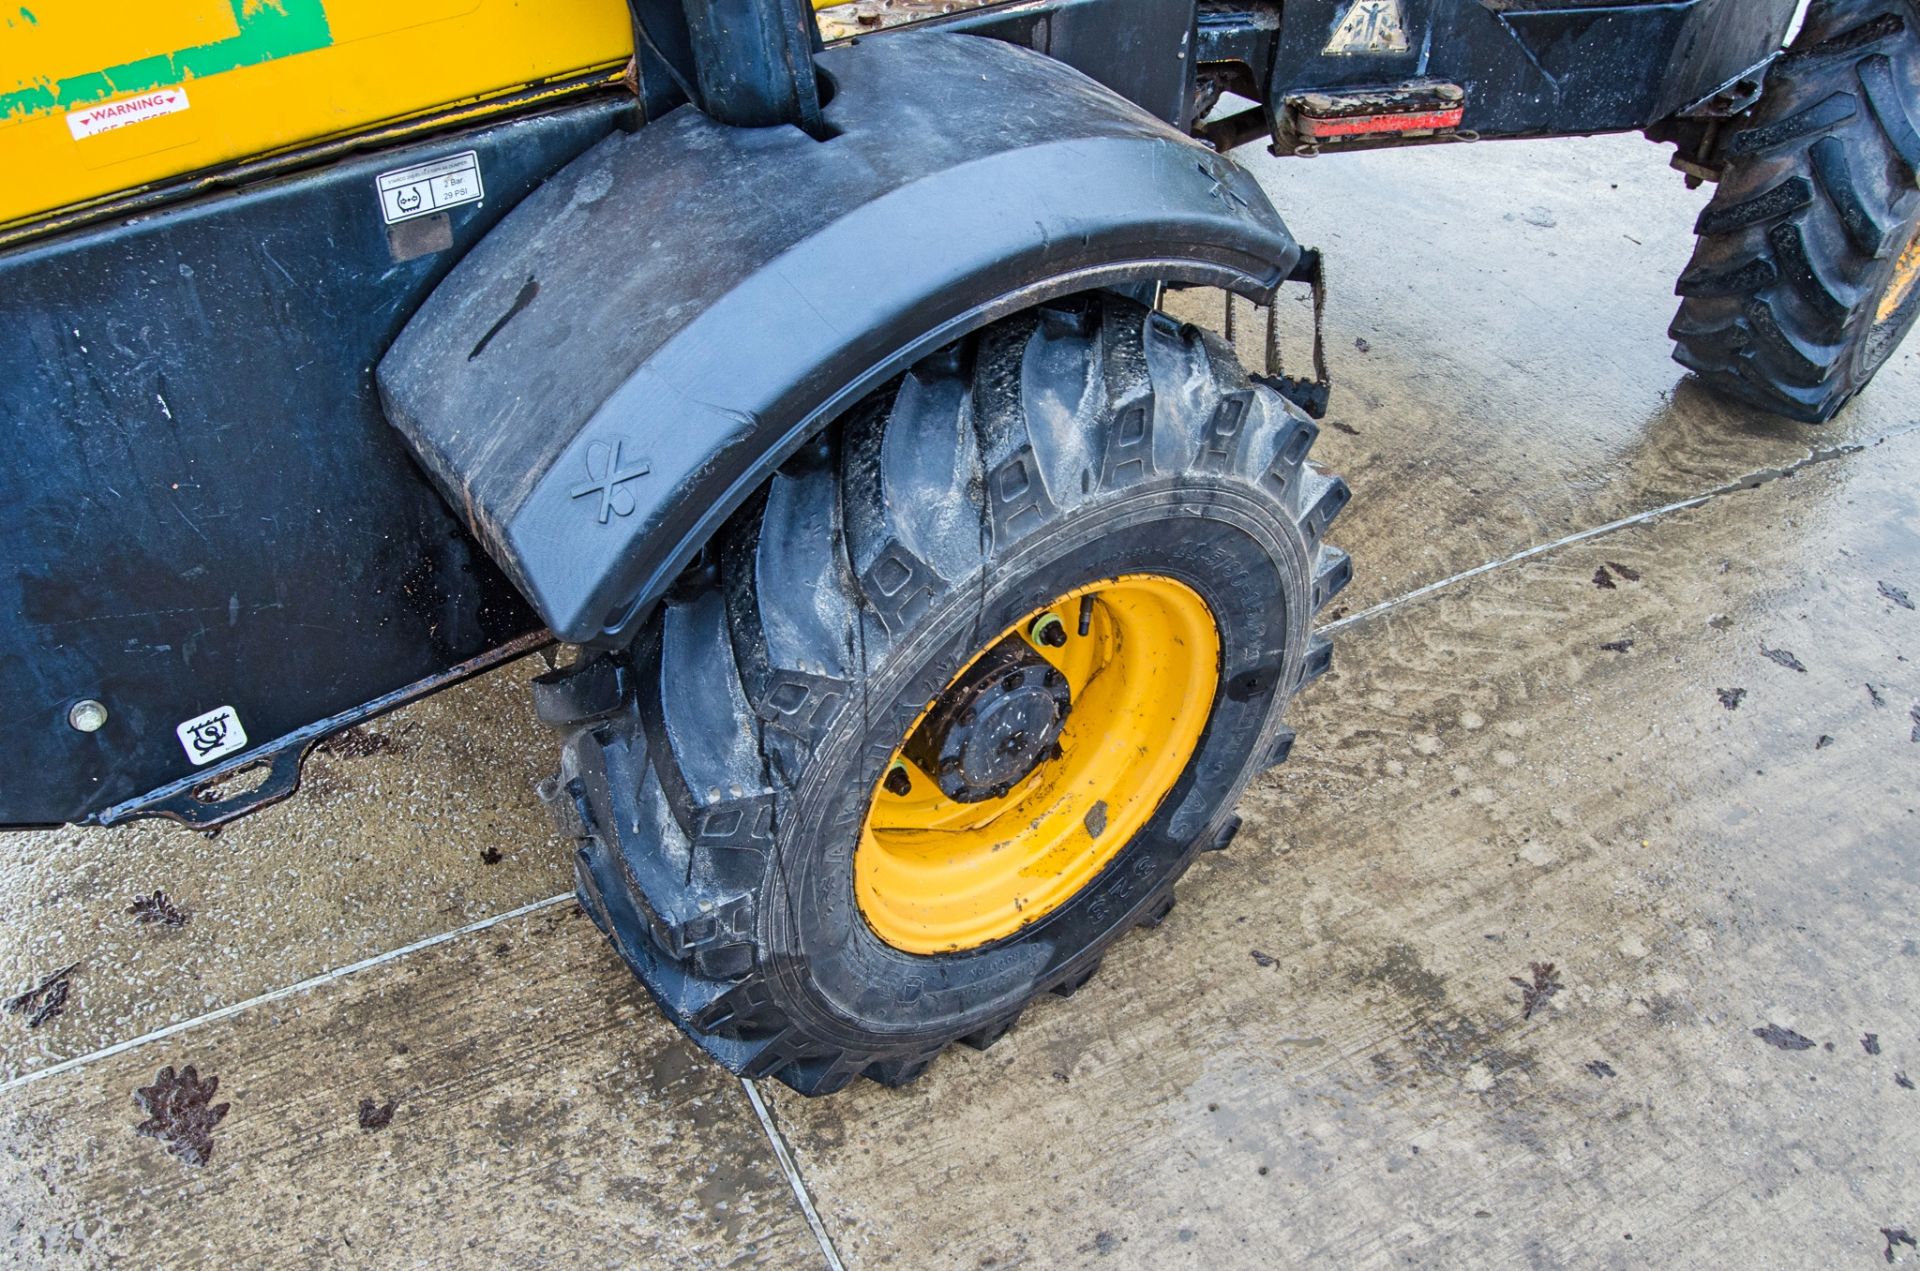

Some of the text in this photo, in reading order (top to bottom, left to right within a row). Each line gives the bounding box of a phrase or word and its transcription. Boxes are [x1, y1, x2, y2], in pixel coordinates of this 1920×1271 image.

[90, 95, 164, 121] WARNING
[450, 177, 463, 185] Bar
[443, 191, 453, 200] 29
[454, 187, 468, 196] PSI
[1087, 855, 1157, 925] 323
